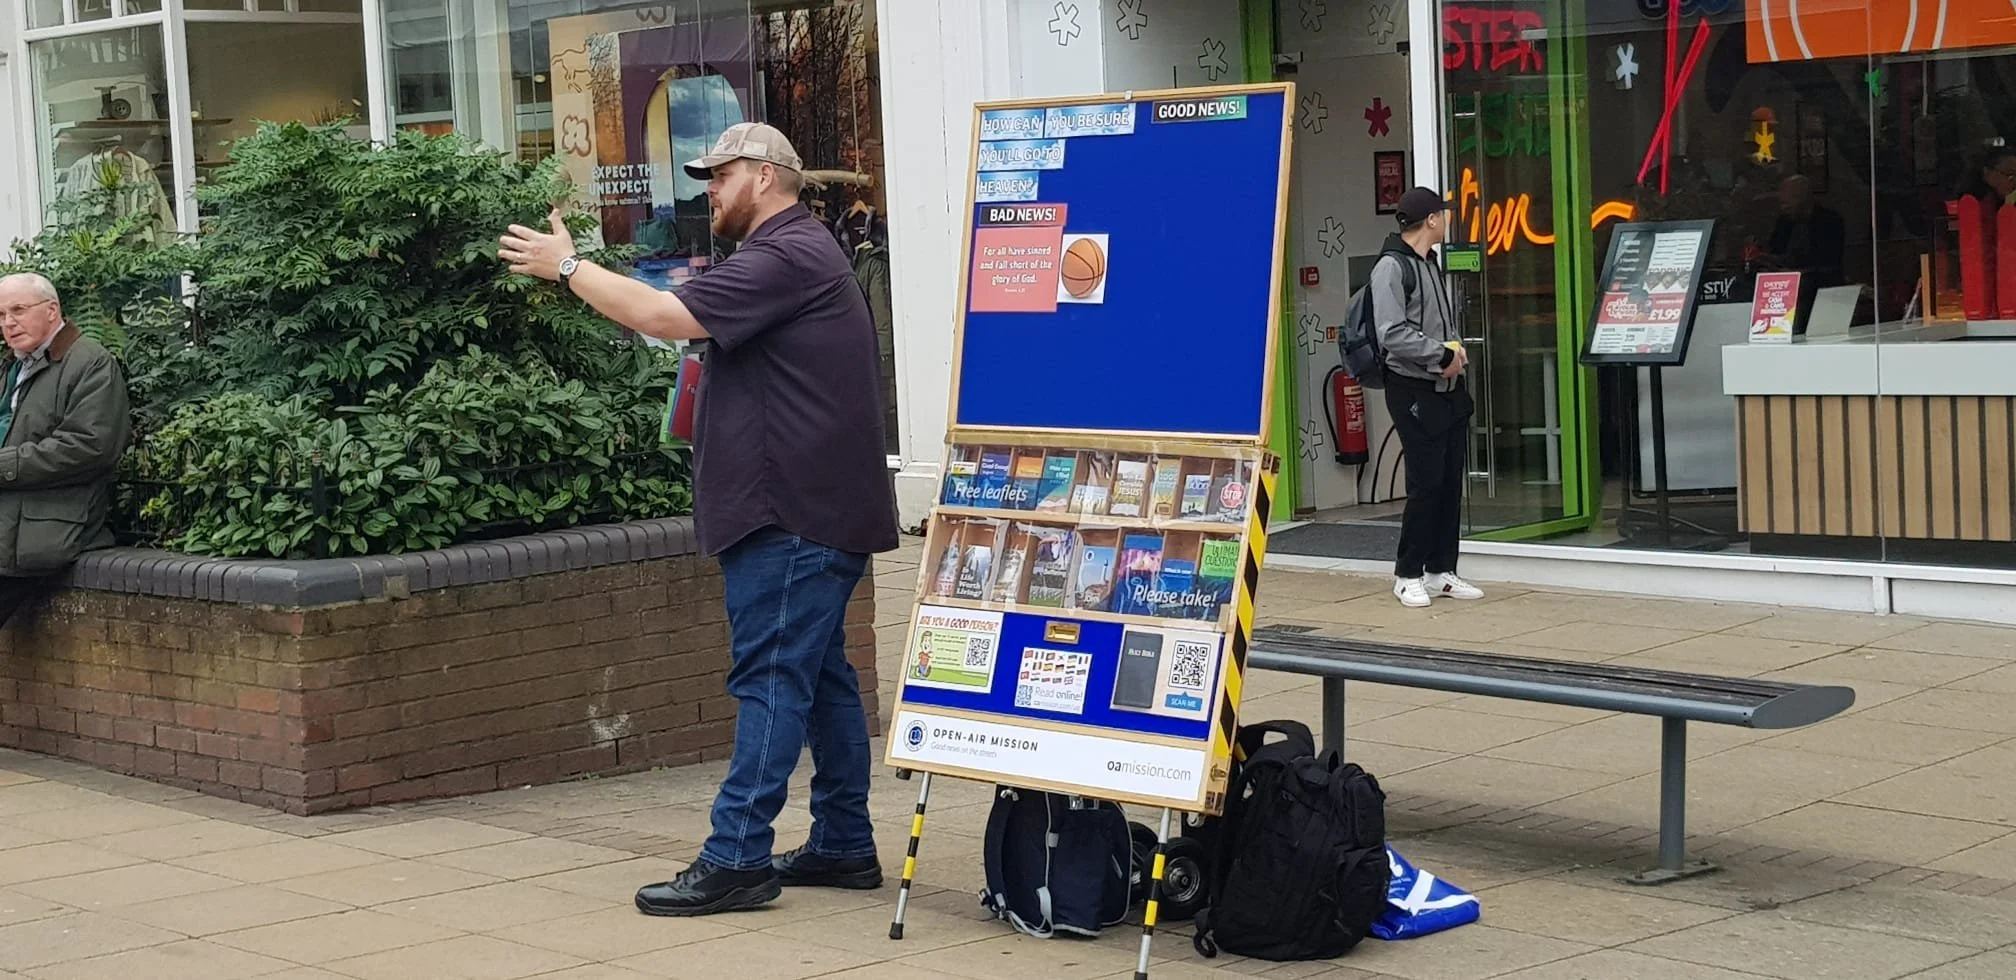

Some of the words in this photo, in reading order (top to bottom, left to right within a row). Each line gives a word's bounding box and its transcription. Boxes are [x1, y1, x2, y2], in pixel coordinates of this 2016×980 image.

[1158, 103, 1196, 119] GOOD
[1198, 100, 1241, 116] NEWS!
[984, 119, 1014, 132] HOW
[1014, 117, 1040, 130] CAN
[1052, 115, 1077, 129] YOU
[1078, 114, 1093, 127] BE
[1094, 112, 1130, 126] SURE
[981, 149, 1022, 163] YOU'LL
[1024, 149, 1042, 161] GO
[1044, 148, 1061, 160] TO
[592, 165, 635, 180] EXPECT
[637, 163, 661, 177] THE
[589, 180, 657, 197] UNEXPECTE
[979, 180, 1034, 194] HEAVEN?
[990, 208, 1015, 221] BAD
[1017, 207, 1057, 221] NEWS!
[983, 246, 996, 256] For
[997, 246, 1007, 256] all
[1008, 246, 1026, 256] have
[1027, 246, 1052, 256] sinned
[980, 260, 994, 270] and
[995, 260, 1008, 270] fall
[1009, 260, 1029, 269] short
[1030, 260, 1039, 269] of
[1040, 259, 1052, 269] the
[992, 274, 1010, 286] glory
[1012, 274, 1020, 283] of
[1021, 274, 1037, 283] God.
[1647, 308, 1681, 321] £1.99
[953, 482, 981, 498] Free
[982, 483, 1029, 502] leaflets
[1223, 490, 1243, 502] STOP
[959, 580, 981, 589] Worth
[956, 587, 982, 598] Living?
[1132, 585, 1177, 604] Please
[1180, 590, 1218, 608] take!
[932, 616, 945, 626] YOU
[945, 617, 950, 627] A
[950, 618, 969, 629] GOOD
[969, 619, 999, 632] PERSON?
[1035, 686, 1055, 698] Read
[1056, 690, 1083, 701] online!
[1171, 697, 1187, 706] SCAN
[1187, 699, 1197, 708] ME
[931, 741, 946, 750] Good
[933, 728, 986, 744] OPEN-AIR
[990, 736, 1039, 751] MISSION
[1107, 760, 1192, 781] oamission.com
